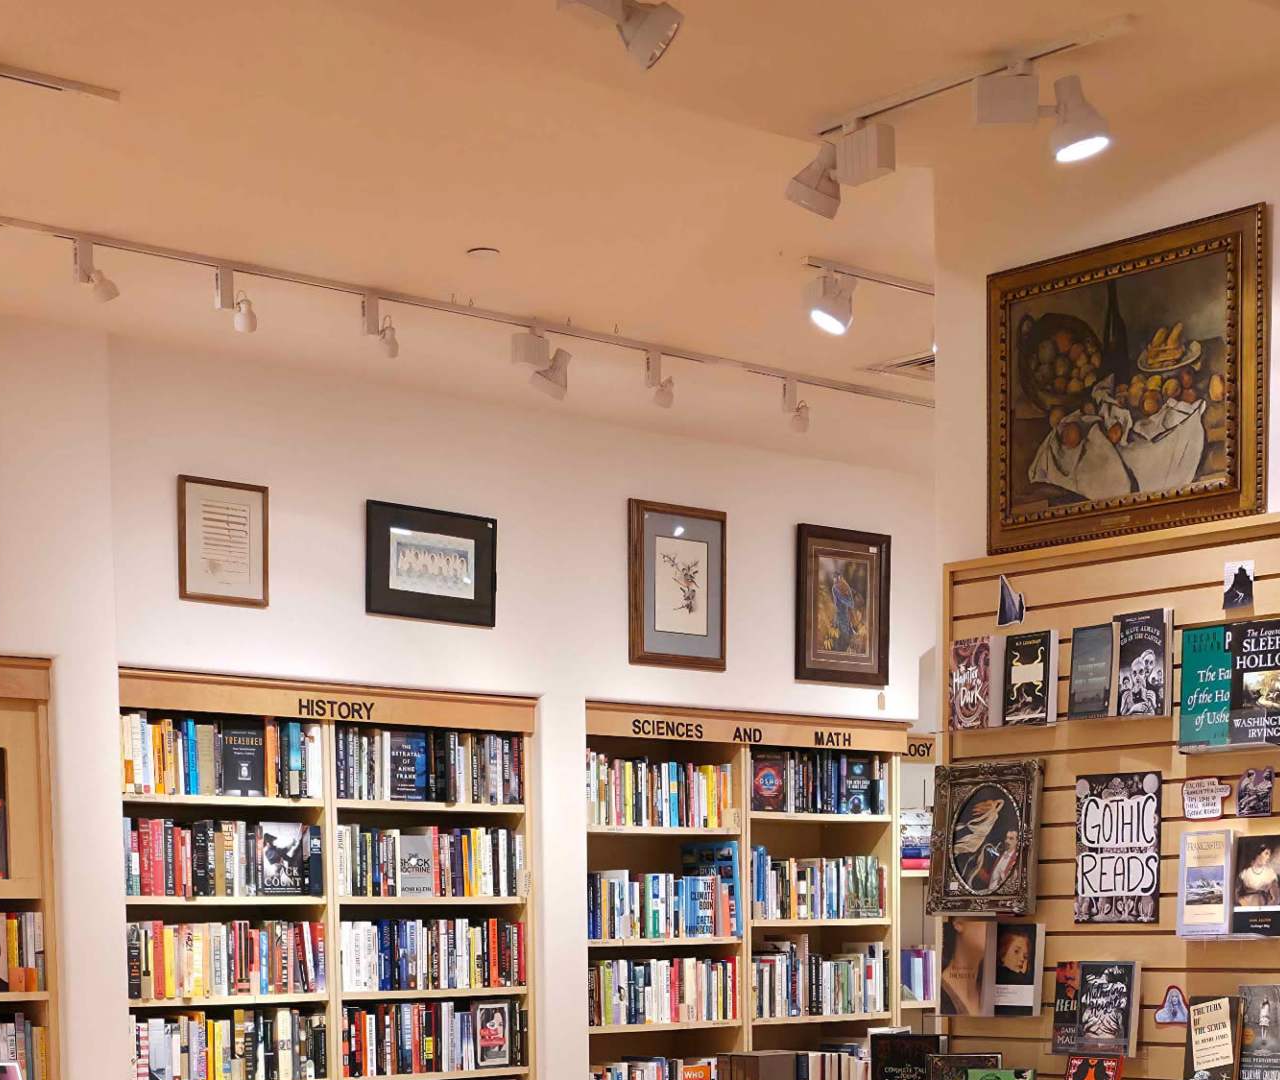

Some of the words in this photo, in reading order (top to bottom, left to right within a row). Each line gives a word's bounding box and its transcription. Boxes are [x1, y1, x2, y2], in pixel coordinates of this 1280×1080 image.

[1247, 629, 1258, 637] The
[1258, 626, 1280, 637] Legend
[1198, 668, 1215, 682] The
[1187, 694, 1196, 706] of
[1197, 690, 1211, 704] the
[298, 698, 375, 721] HISTORY
[1195, 715, 1205, 732] of
[631, 719, 704, 740] SCIENCES
[732, 726, 763, 743] AND
[813, 731, 852, 747] MATH
[1248, 727, 1280, 738] IRVING
[1082, 794, 1156, 846] GOTHIC
[264, 876, 301, 887] COUNT
[1080, 855, 1158, 897] READS
[703, 881, 714, 891] THE
[684, 1070, 705, 1080] WHO
